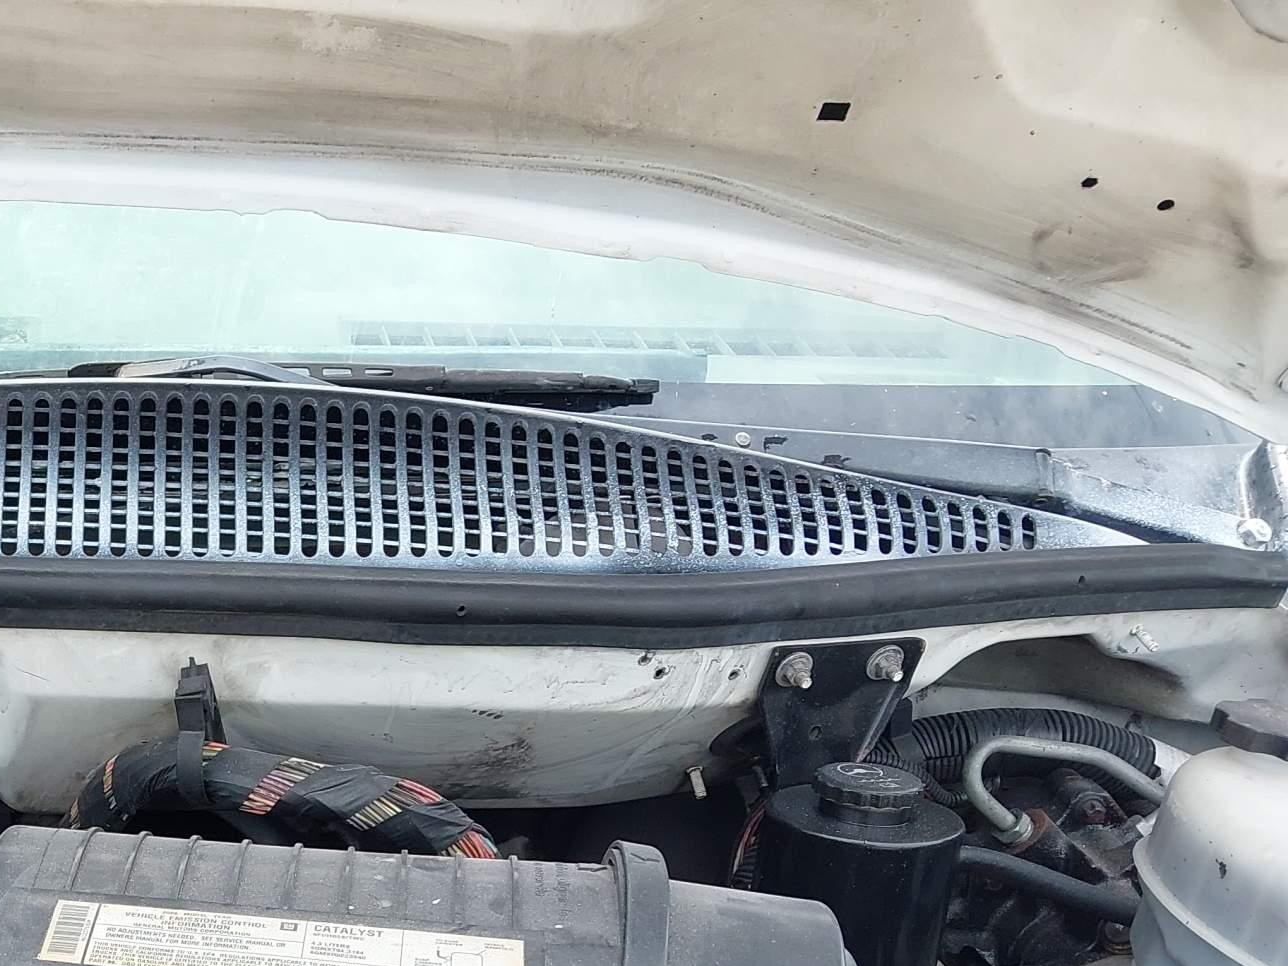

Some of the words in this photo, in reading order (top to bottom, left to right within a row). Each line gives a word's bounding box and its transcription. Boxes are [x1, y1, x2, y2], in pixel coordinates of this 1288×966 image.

[160, 920, 231, 930] INFORMATION
[169, 915, 217, 924] EMISSION
[221, 920, 268, 929] CONTROL
[118, 928, 167, 937] ADJUSTMENTS
[200, 929, 251, 937] CORPORATION
[314, 925, 384, 938] CATALYST
